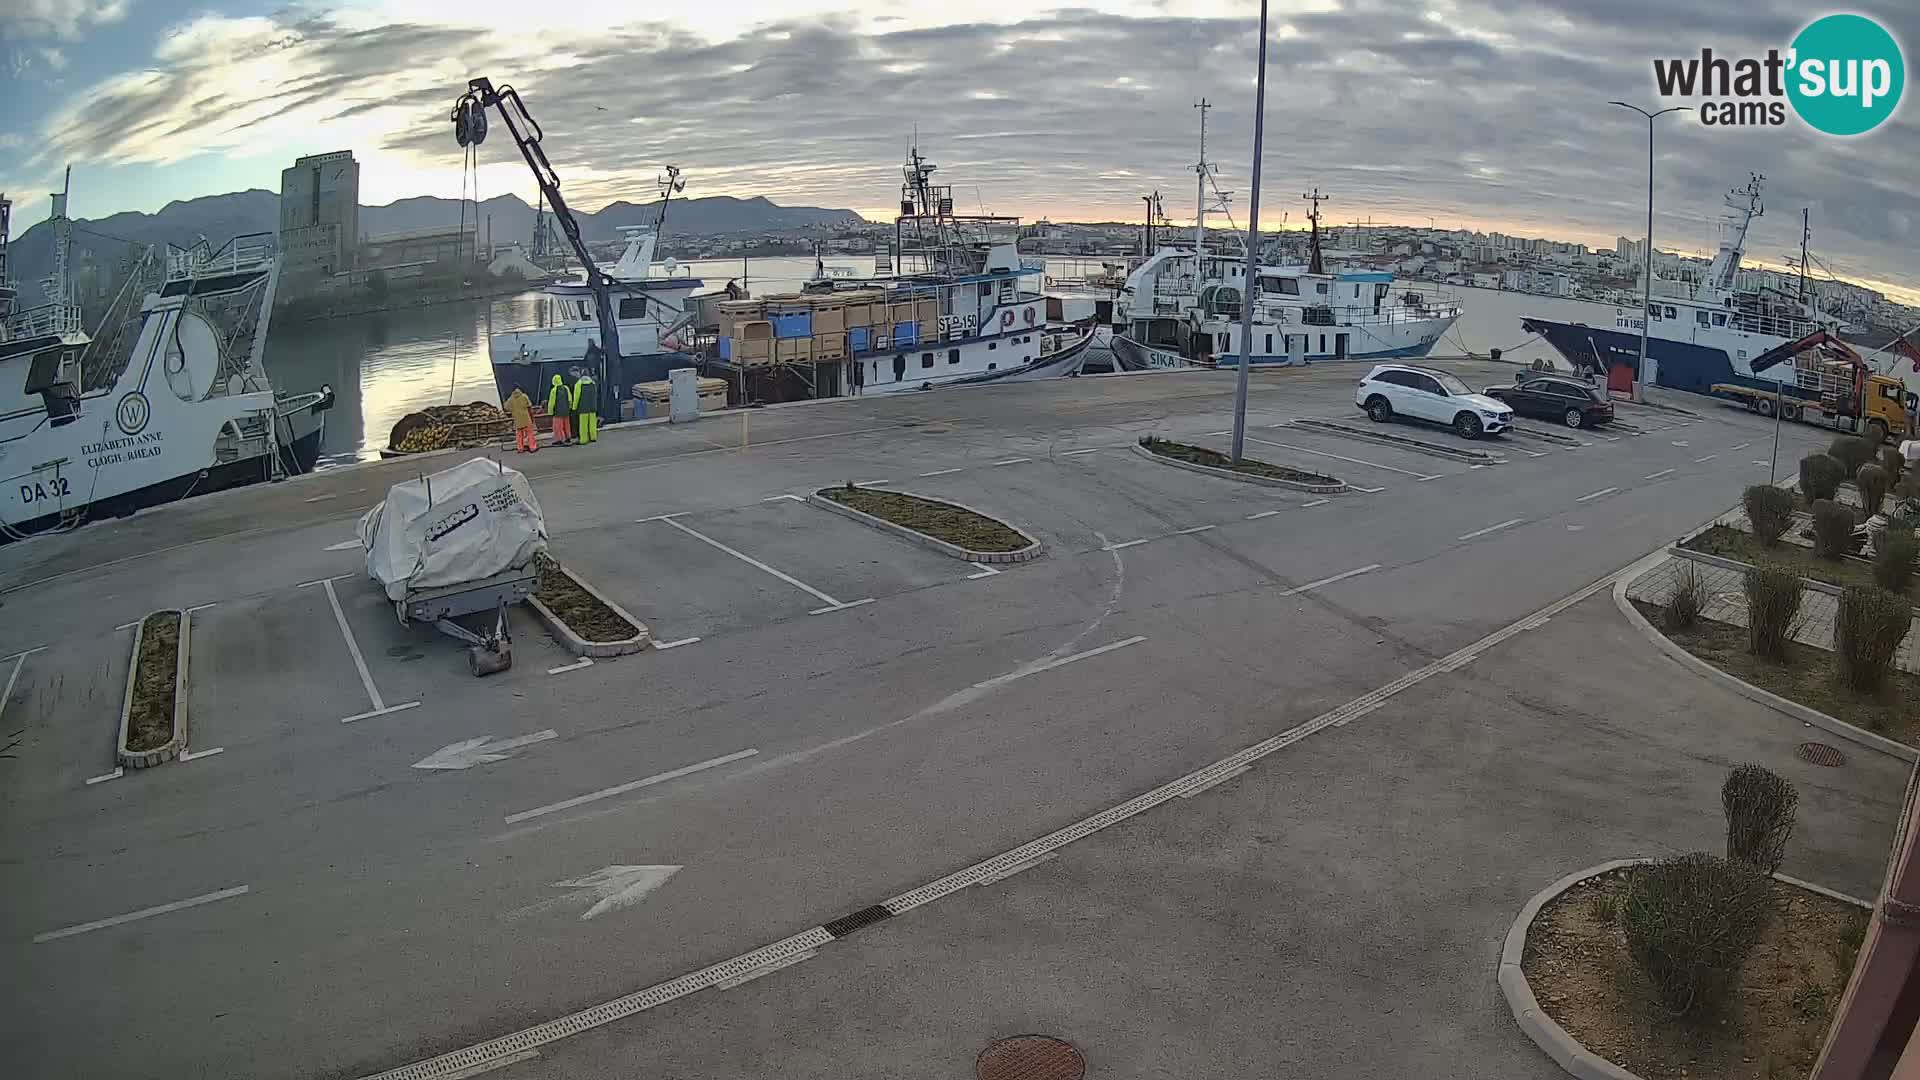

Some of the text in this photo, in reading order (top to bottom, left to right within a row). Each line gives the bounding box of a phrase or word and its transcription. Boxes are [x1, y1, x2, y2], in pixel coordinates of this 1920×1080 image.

[1150, 352, 1175, 368] SIKA
[81, 431, 163, 455] ELIZABETH ANNE
[20, 478, 71, 504] DA 32
